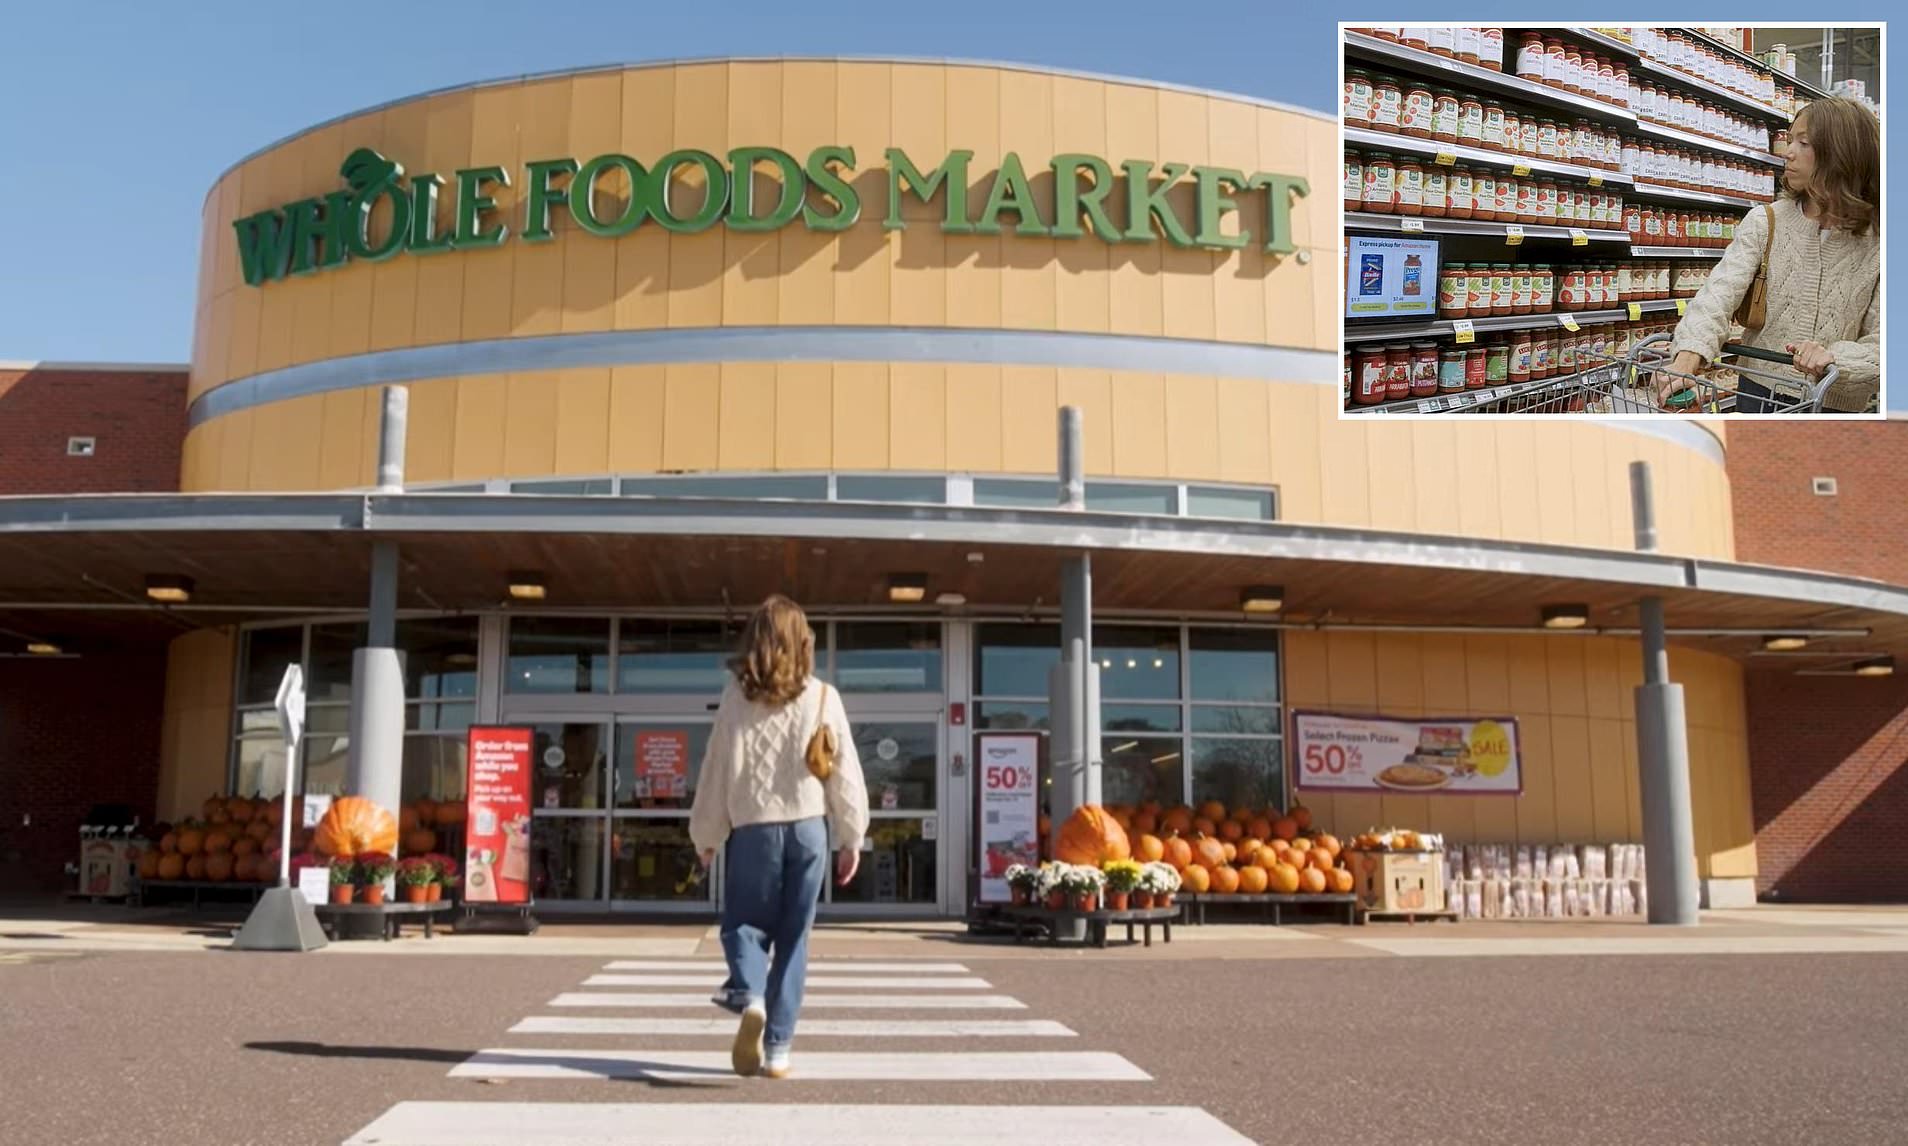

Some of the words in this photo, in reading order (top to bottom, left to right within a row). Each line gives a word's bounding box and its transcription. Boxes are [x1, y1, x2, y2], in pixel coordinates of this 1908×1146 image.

[233, 147, 511, 287] WHOLE
[521, 146, 862, 242] FOODS
[882, 147, 1311, 255] MARKET
[1359, 240, 1378, 248] Express
[1304, 730, 1334, 740] Select
[1336, 731, 1368, 742] Frozen
[474, 740, 503, 751] Order
[503, 740, 529, 752] from
[1472, 740, 1508, 757] SALE
[986, 765, 1033, 790] 50%
